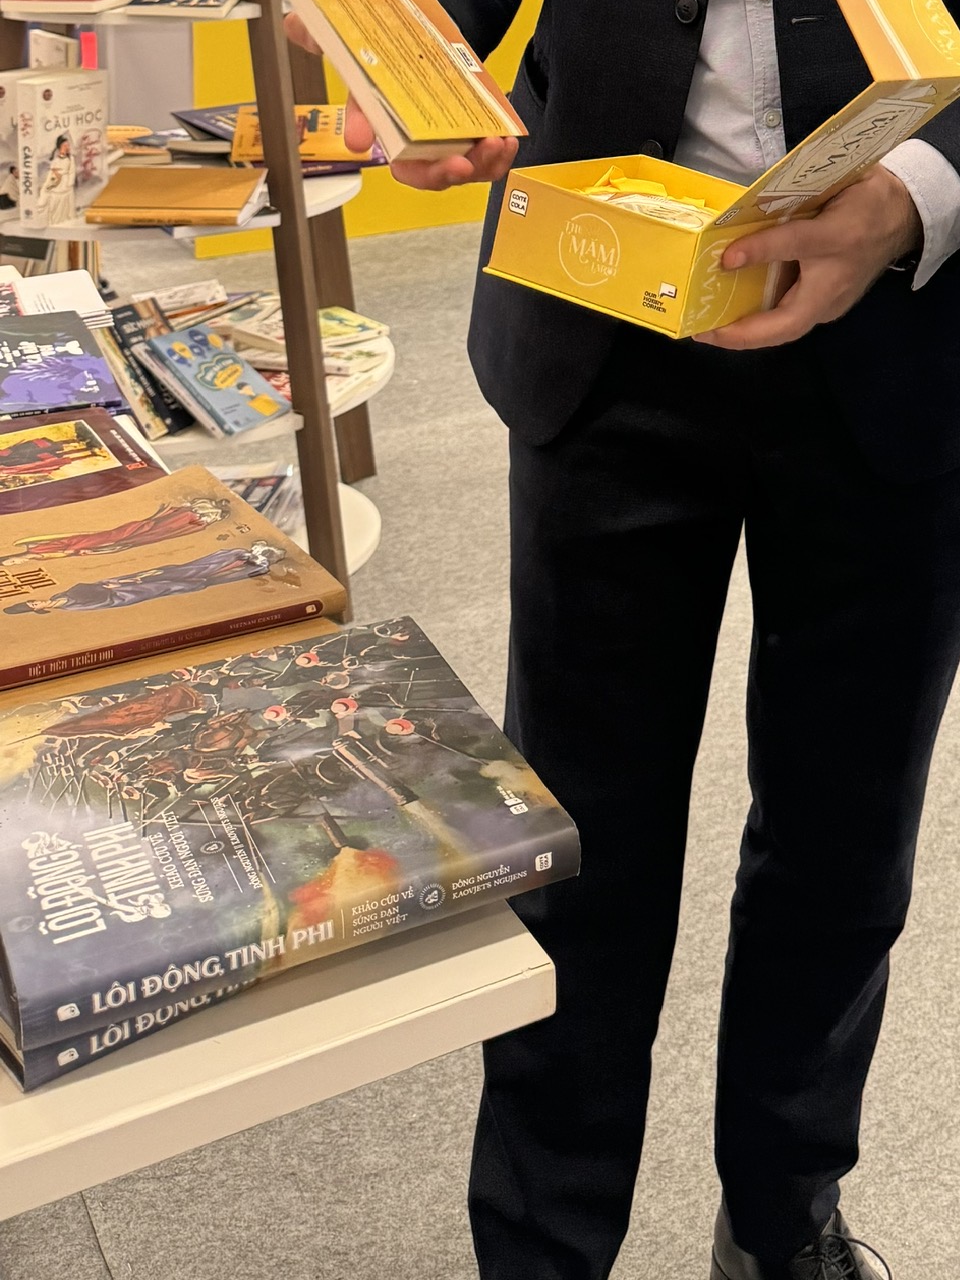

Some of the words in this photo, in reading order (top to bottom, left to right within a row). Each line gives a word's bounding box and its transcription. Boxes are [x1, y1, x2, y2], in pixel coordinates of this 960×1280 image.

[510, 201, 525, 210] COLA
[643, 296, 664, 307] HOBBY
[644, 290, 657, 299] OUR
[642, 301, 667, 313] CORNER
[83, 821, 142, 861] PHI
[96, 852, 160, 904] TINH
[452, 882, 492, 900] KAOVJETS
[351, 900, 379, 916] KHẢO
[352, 911, 378, 927] SÚNG
[91, 980, 136, 1014] LÔI
[225, 934, 286, 971] TINH
[292, 919, 335, 950] PHI
[89, 1020, 131, 1055] LÔI
